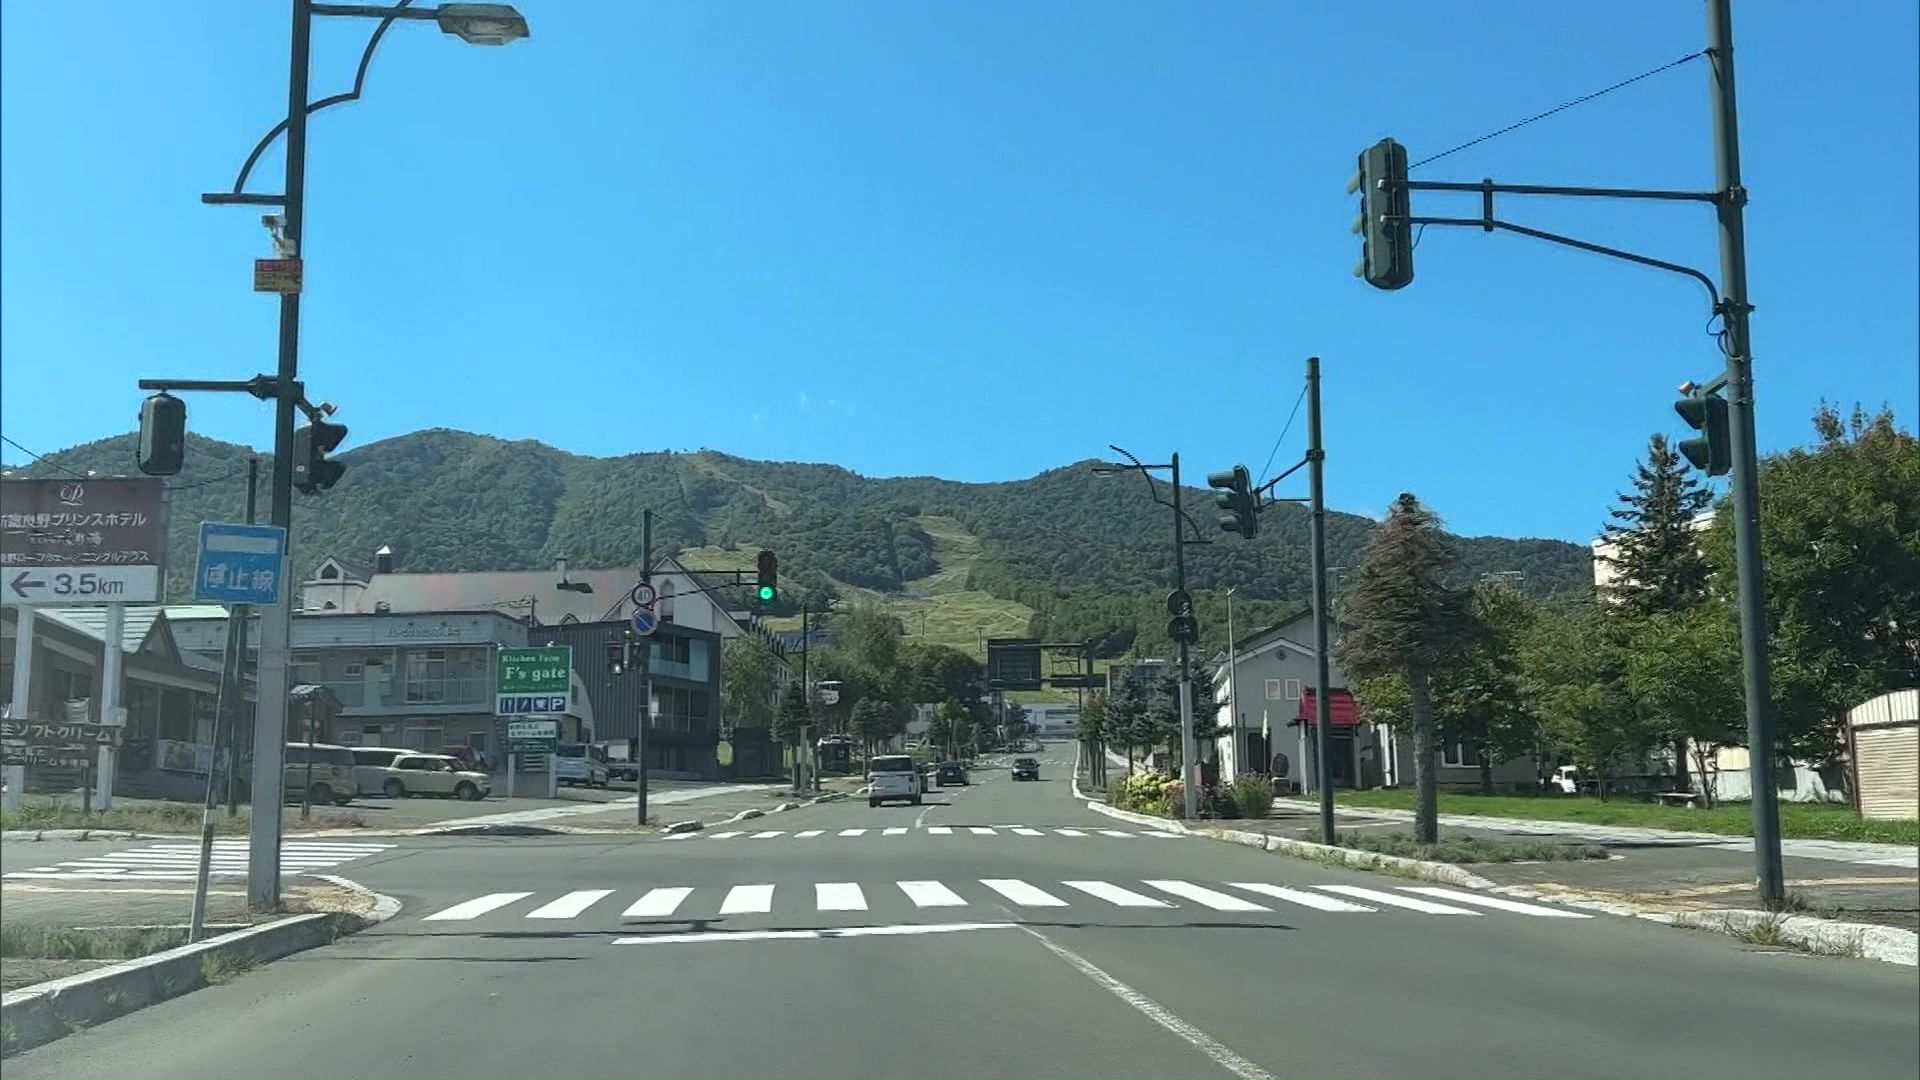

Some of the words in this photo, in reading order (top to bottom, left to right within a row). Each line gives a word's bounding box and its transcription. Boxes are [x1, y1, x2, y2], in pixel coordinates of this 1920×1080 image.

[54, 573, 123, 595] 3.5km
[203, 564, 275, 593] 停止線
[637, 589, 651, 601] 40
[505, 666, 527, 679] F's
[532, 667, 566, 681] gate
